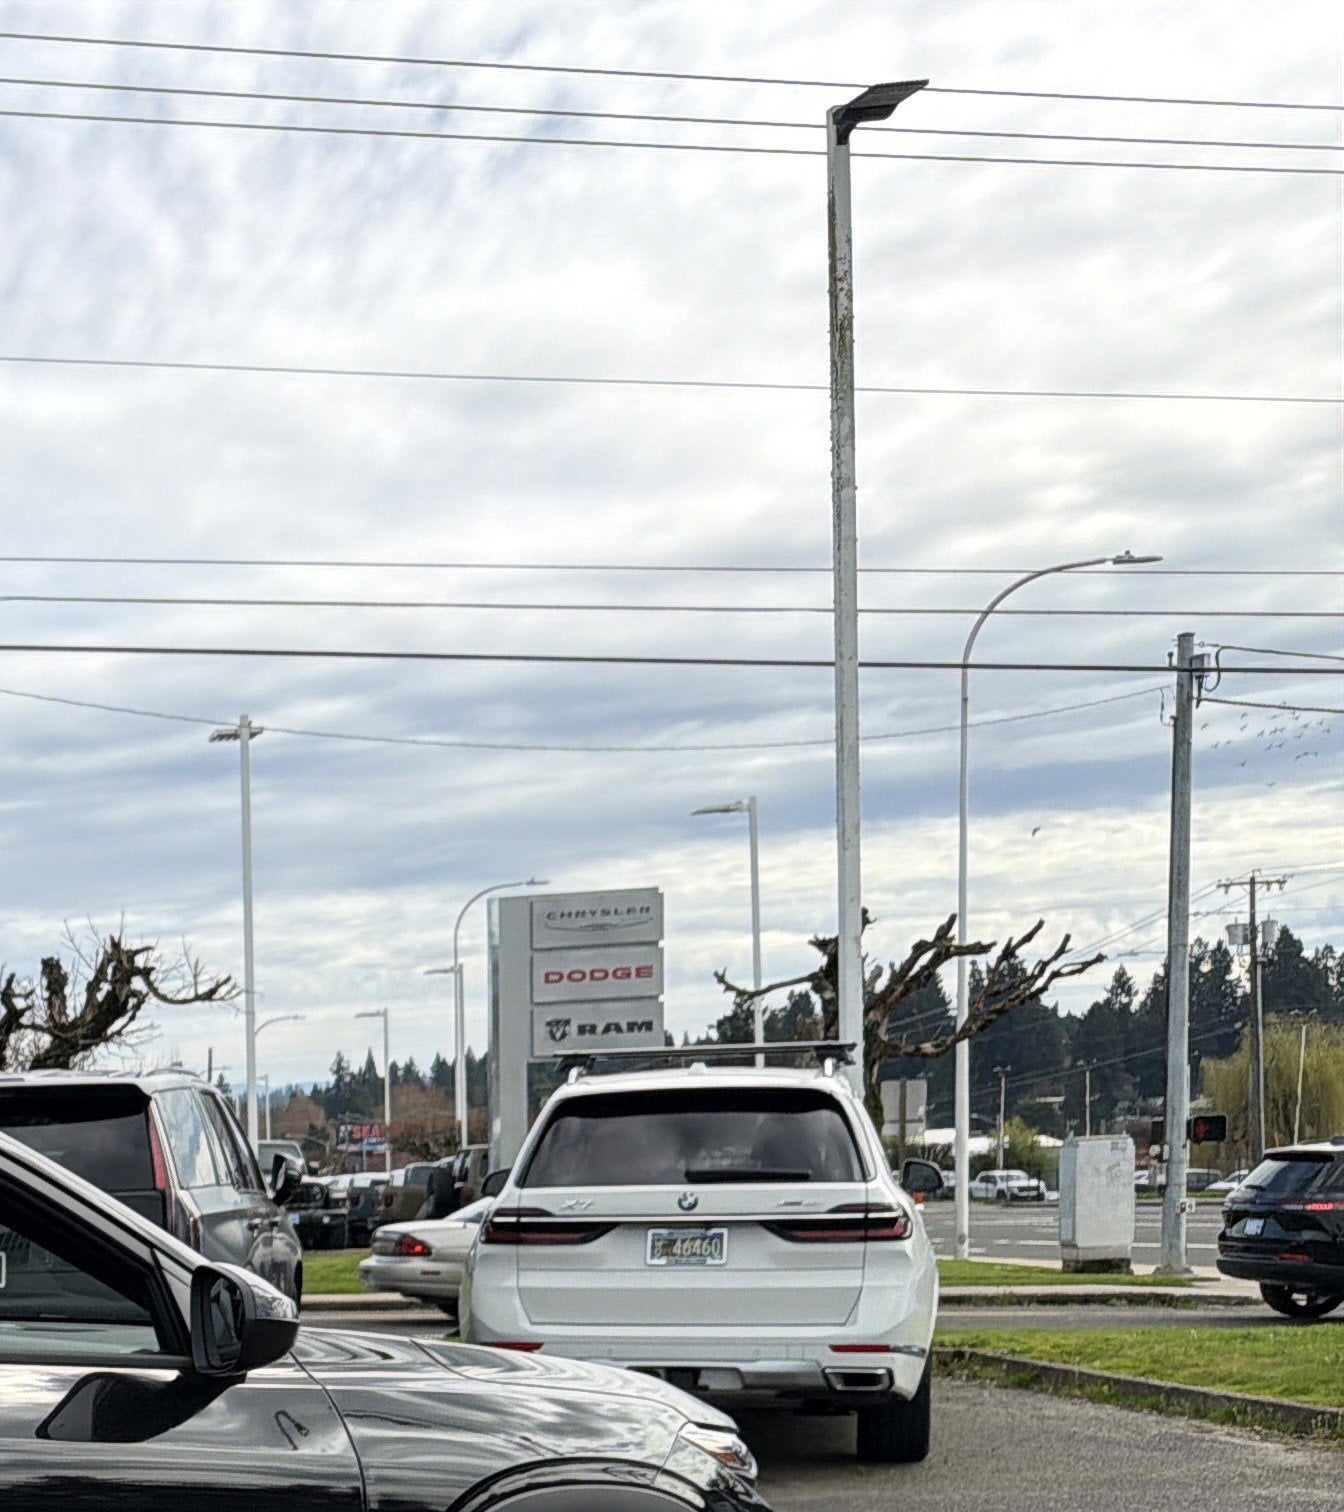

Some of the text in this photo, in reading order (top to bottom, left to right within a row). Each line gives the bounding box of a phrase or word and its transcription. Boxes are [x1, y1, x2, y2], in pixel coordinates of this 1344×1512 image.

[546, 905, 651, 921] CHRYSLER
[544, 965, 654, 985] DODGE
[577, 1020, 654, 1036] RAM
